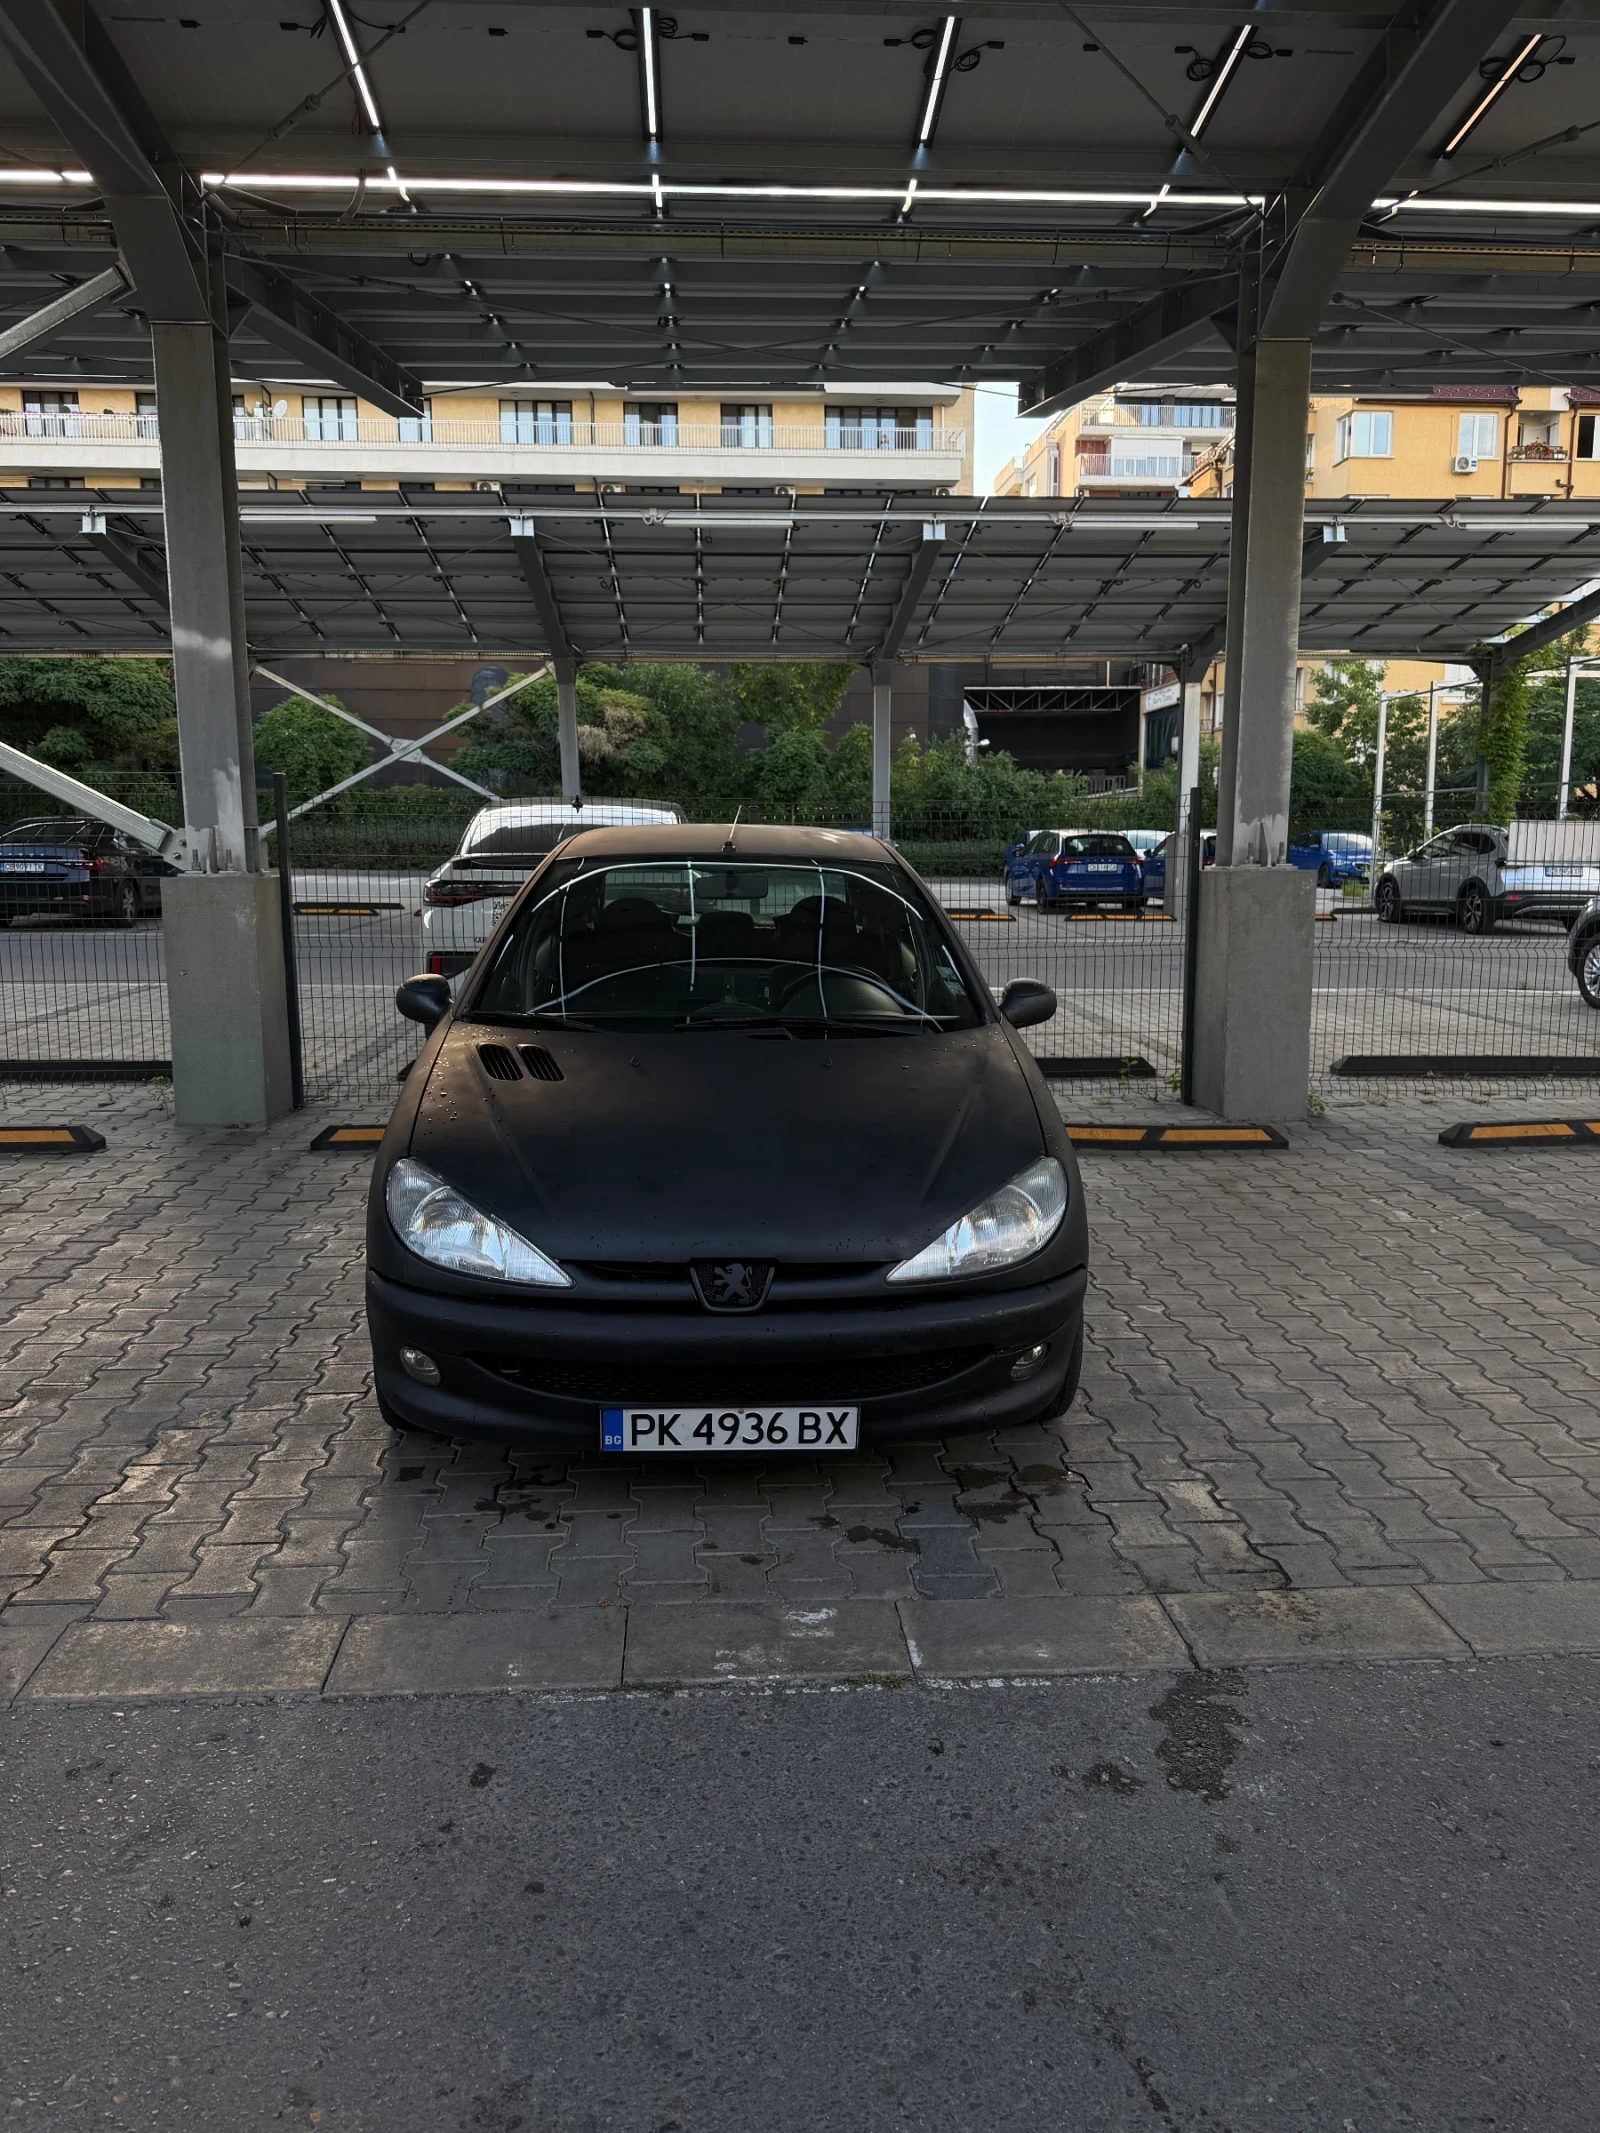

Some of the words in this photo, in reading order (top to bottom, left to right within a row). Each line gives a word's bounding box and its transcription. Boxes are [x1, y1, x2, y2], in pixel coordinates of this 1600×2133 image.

[604, 1434, 622, 1445] BG
[630, 1413, 682, 1446] PK
[692, 1411, 789, 1445] 4936
[797, 1411, 851, 1444] BX
